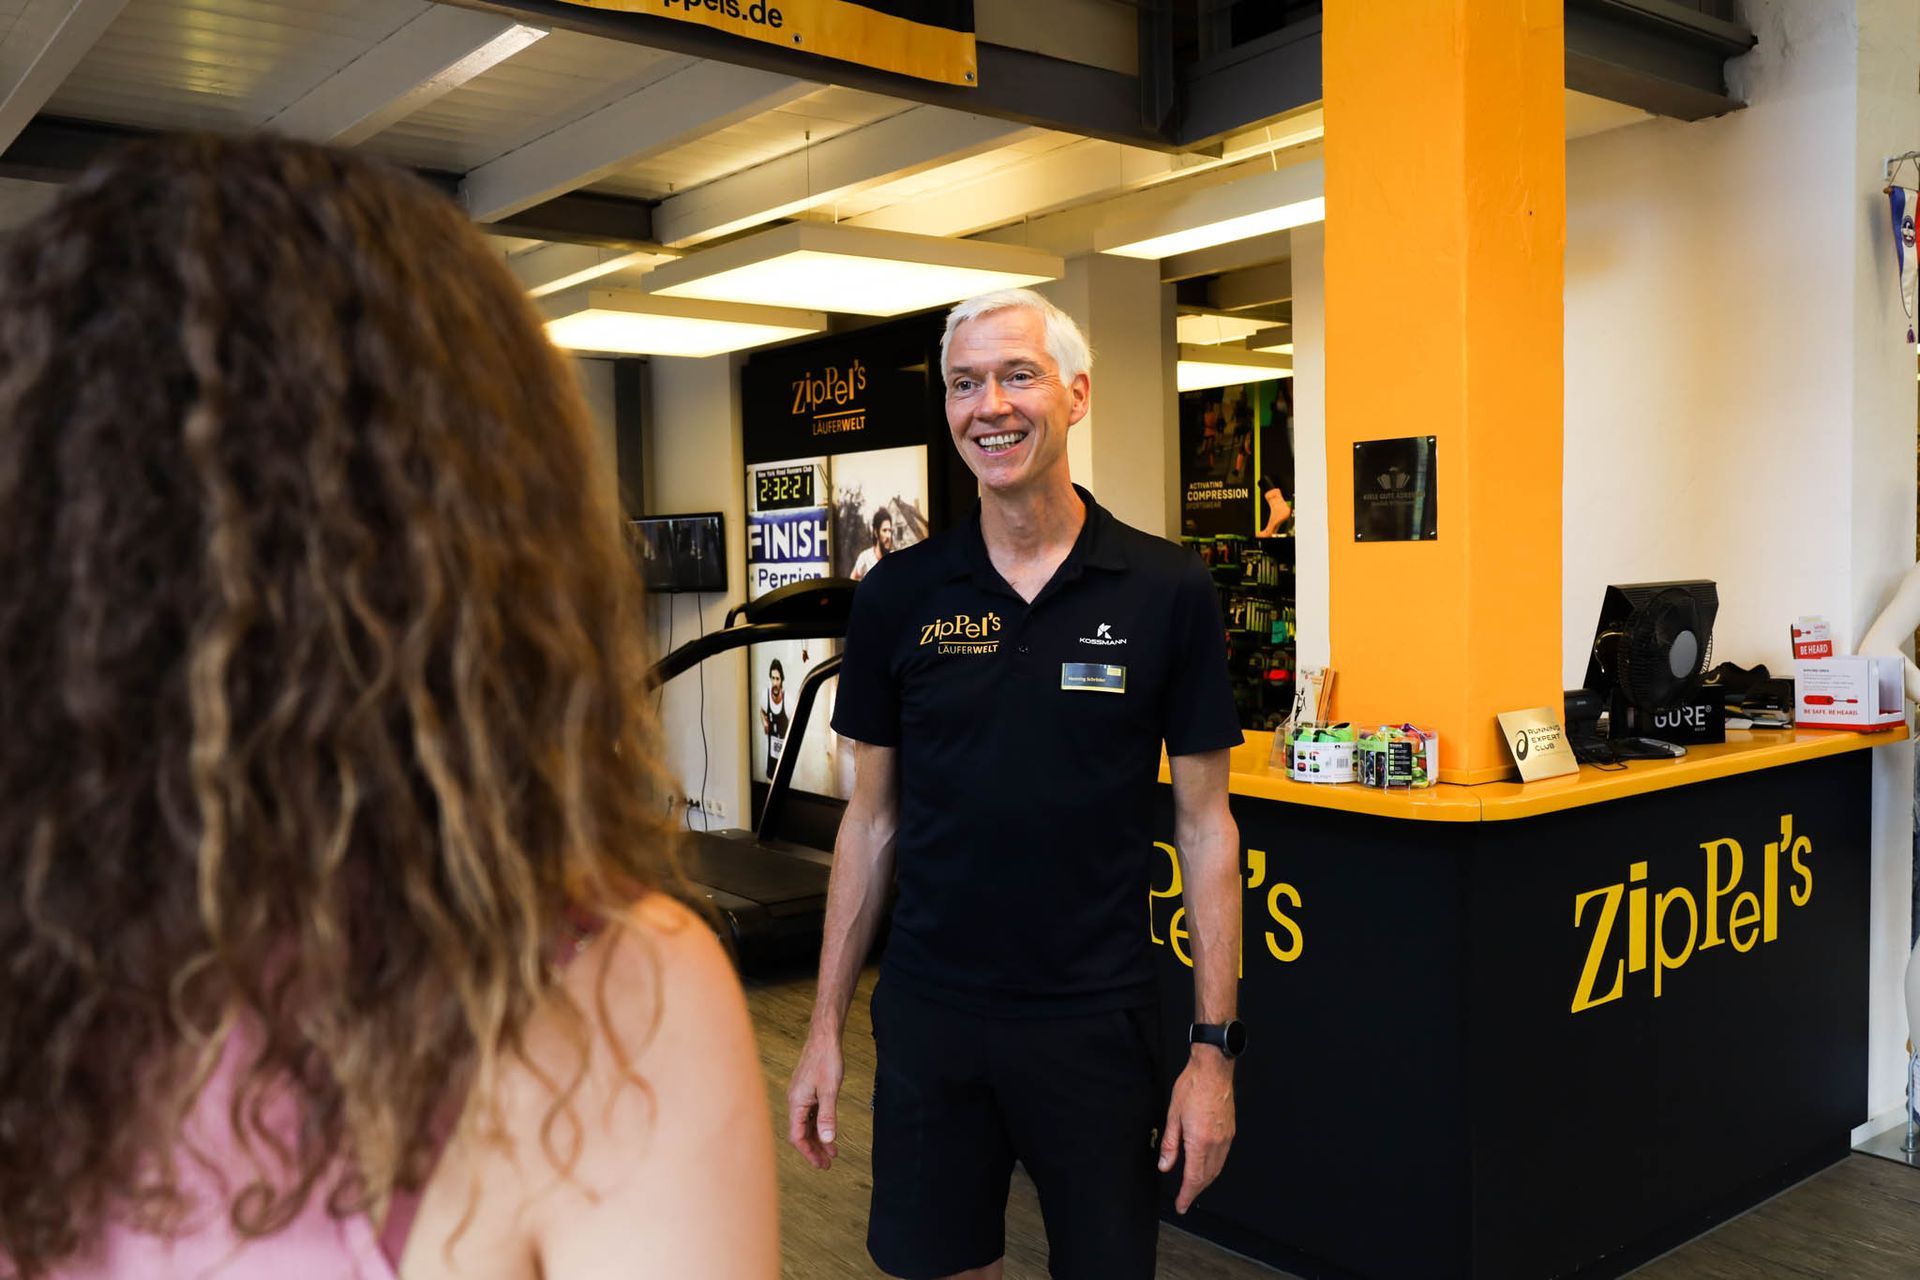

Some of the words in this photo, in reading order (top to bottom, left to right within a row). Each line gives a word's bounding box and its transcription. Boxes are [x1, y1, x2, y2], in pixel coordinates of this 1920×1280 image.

[664, 0, 783, 28] els.de
[813, 416, 866, 436] LÄUFERWELT
[760, 475, 811, 502] 2:32:21
[1189, 480, 1223, 489] ACTIVATING
[1187, 488, 1249, 501] COMPRESSION
[748, 520, 829, 560] FINISH
[1079, 637, 1127, 646] KOSSMANN
[937, 644, 998, 655] LÄUFERWELT
[1800, 645, 1808, 655] BE
[1808, 643, 1828, 655] HEARD
[1527, 724, 1561, 735] RUNNING
[1531, 733, 1561, 744] EXPERT
[1534, 742, 1555, 752] CLUB
[1149, 841, 1304, 979] Pe's
